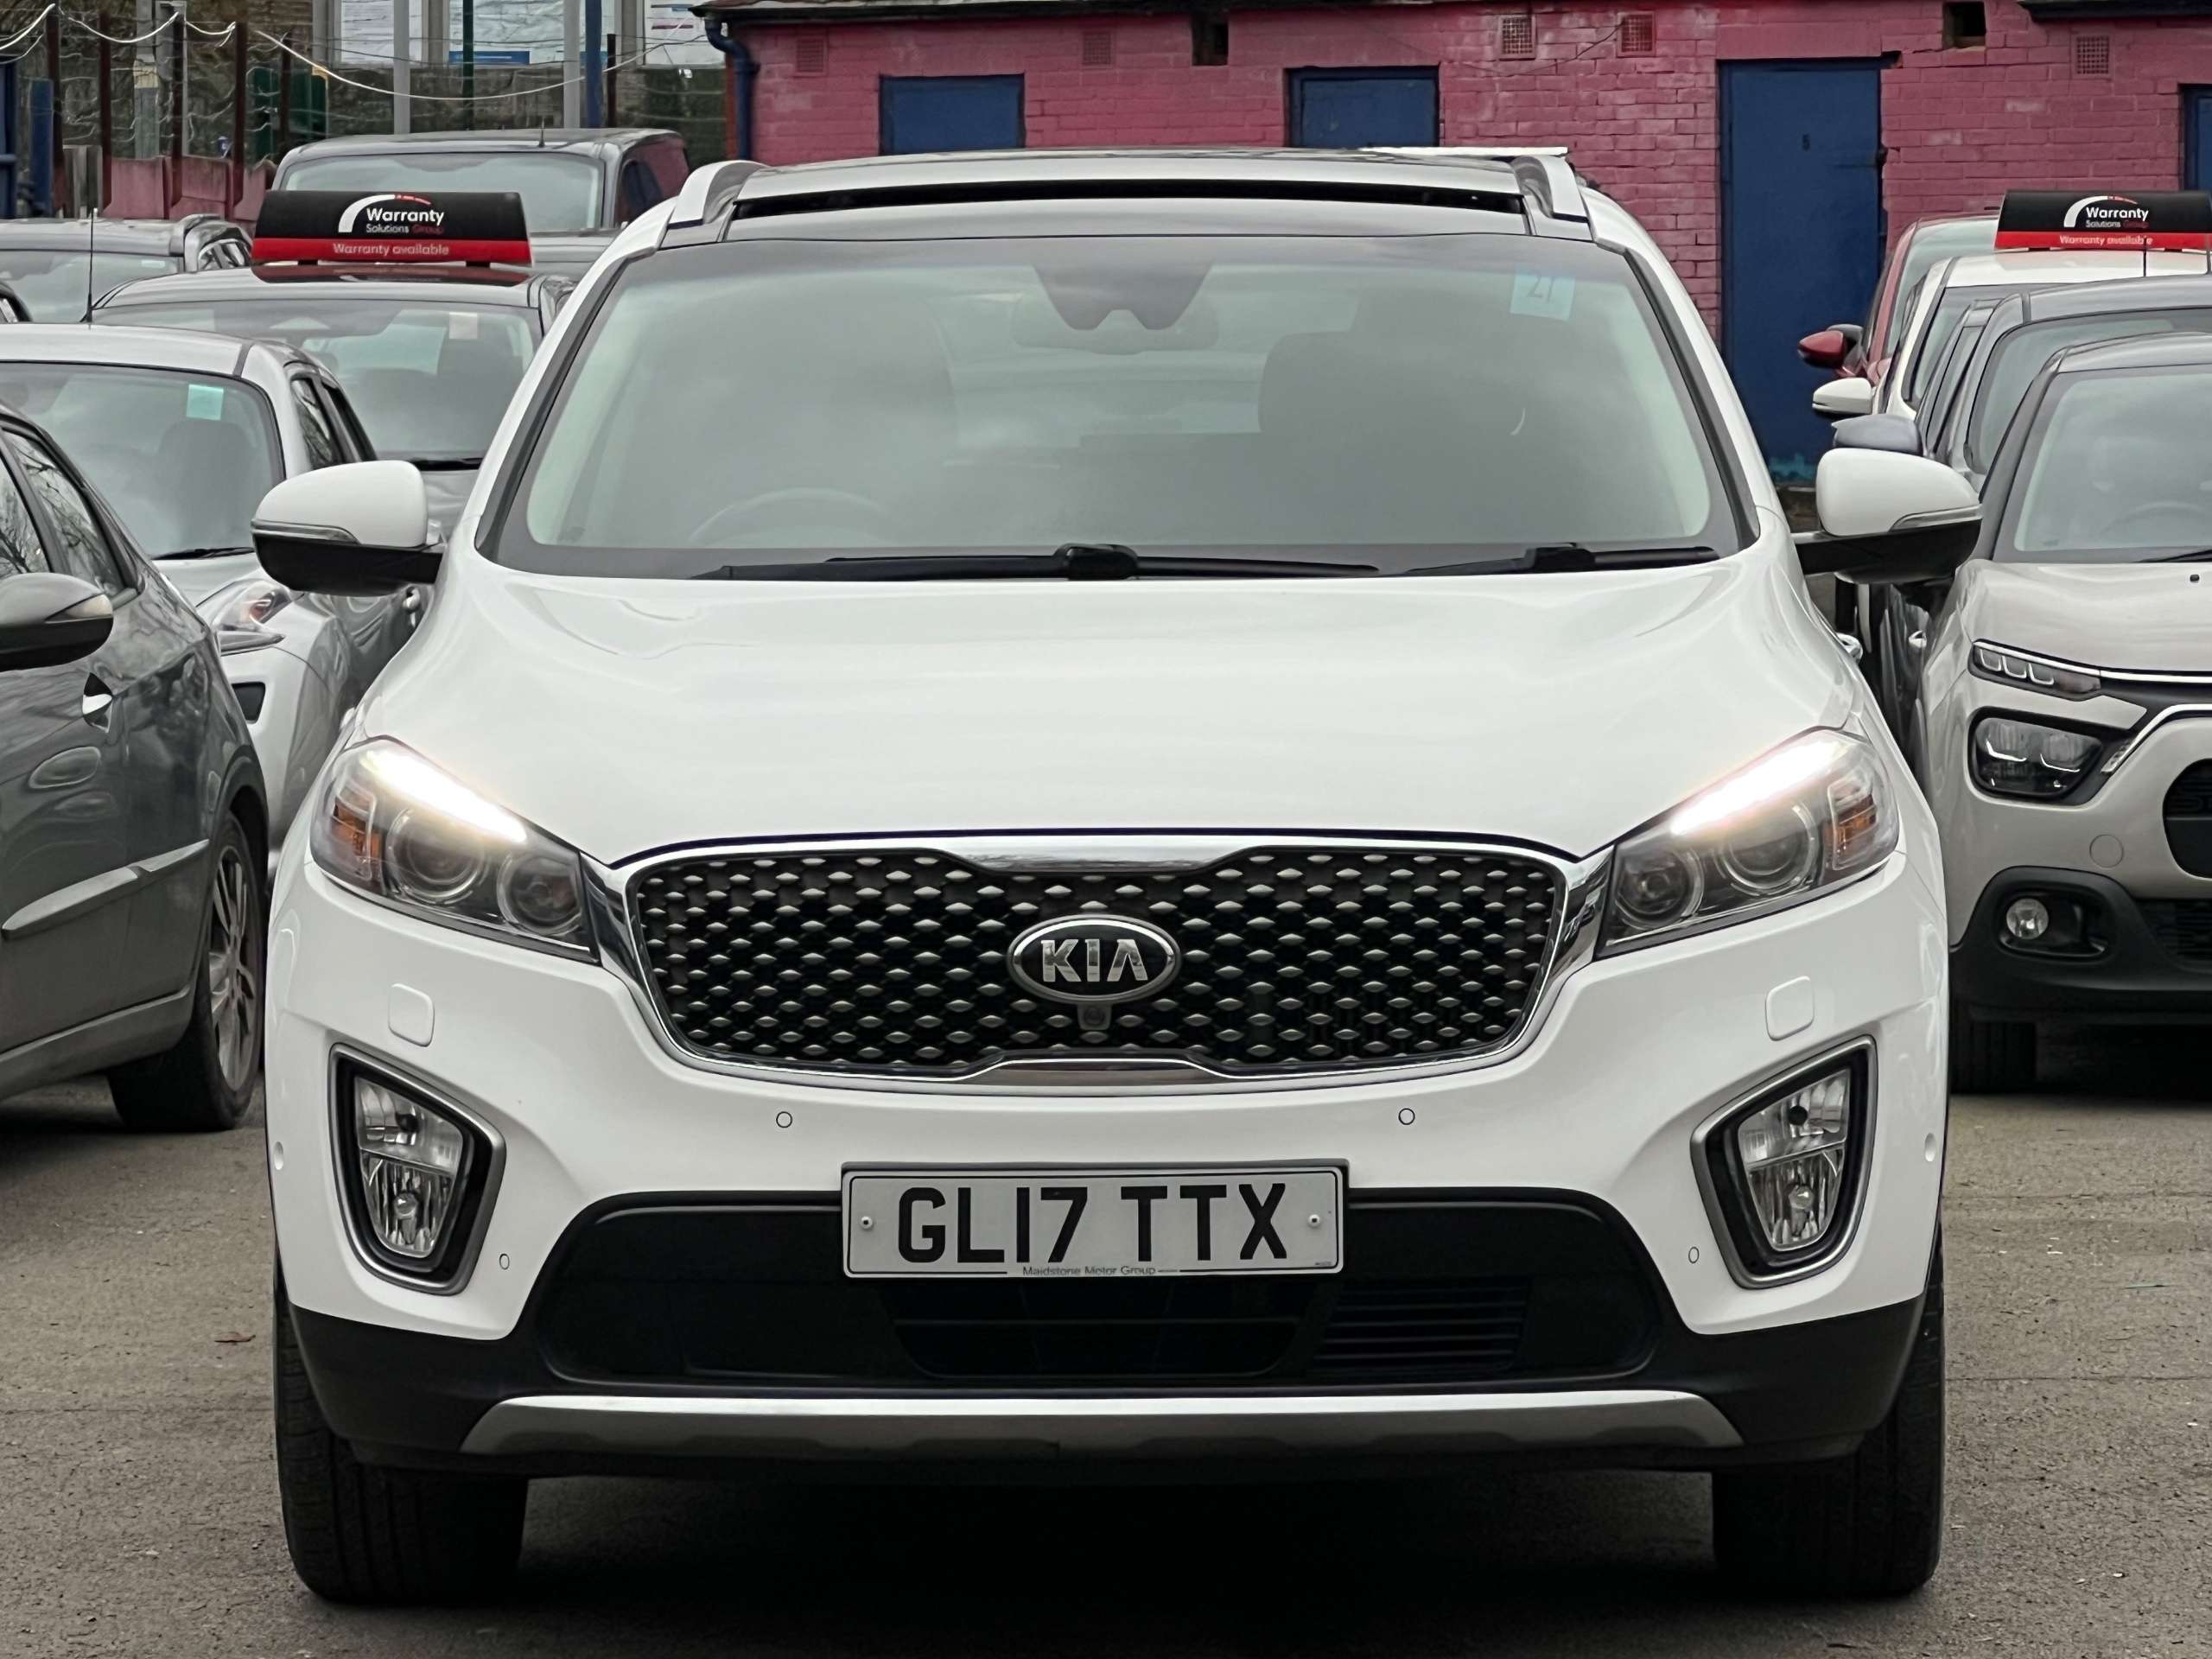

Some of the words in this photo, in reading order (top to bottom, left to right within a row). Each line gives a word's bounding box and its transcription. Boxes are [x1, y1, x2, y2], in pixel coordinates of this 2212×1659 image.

[366, 207, 444, 226] Warranty
[2086, 207, 2149, 221] Warranty
[366, 223, 410, 233] Solutions
[2086, 219, 2121, 228] Solutions
[2060, 235, 2105, 246] Warranty
[333, 243, 390, 256] Warranty
[392, 244, 449, 255] available
[1041, 939, 1147, 982] KIA
[898, 1186, 1088, 1263] GL17
[1121, 1183, 1287, 1262] TTX
[1022, 1266, 1081, 1275] Maidstone
[1084, 1266, 1117, 1275] Motor
[1121, 1265, 1156, 1276] Group
